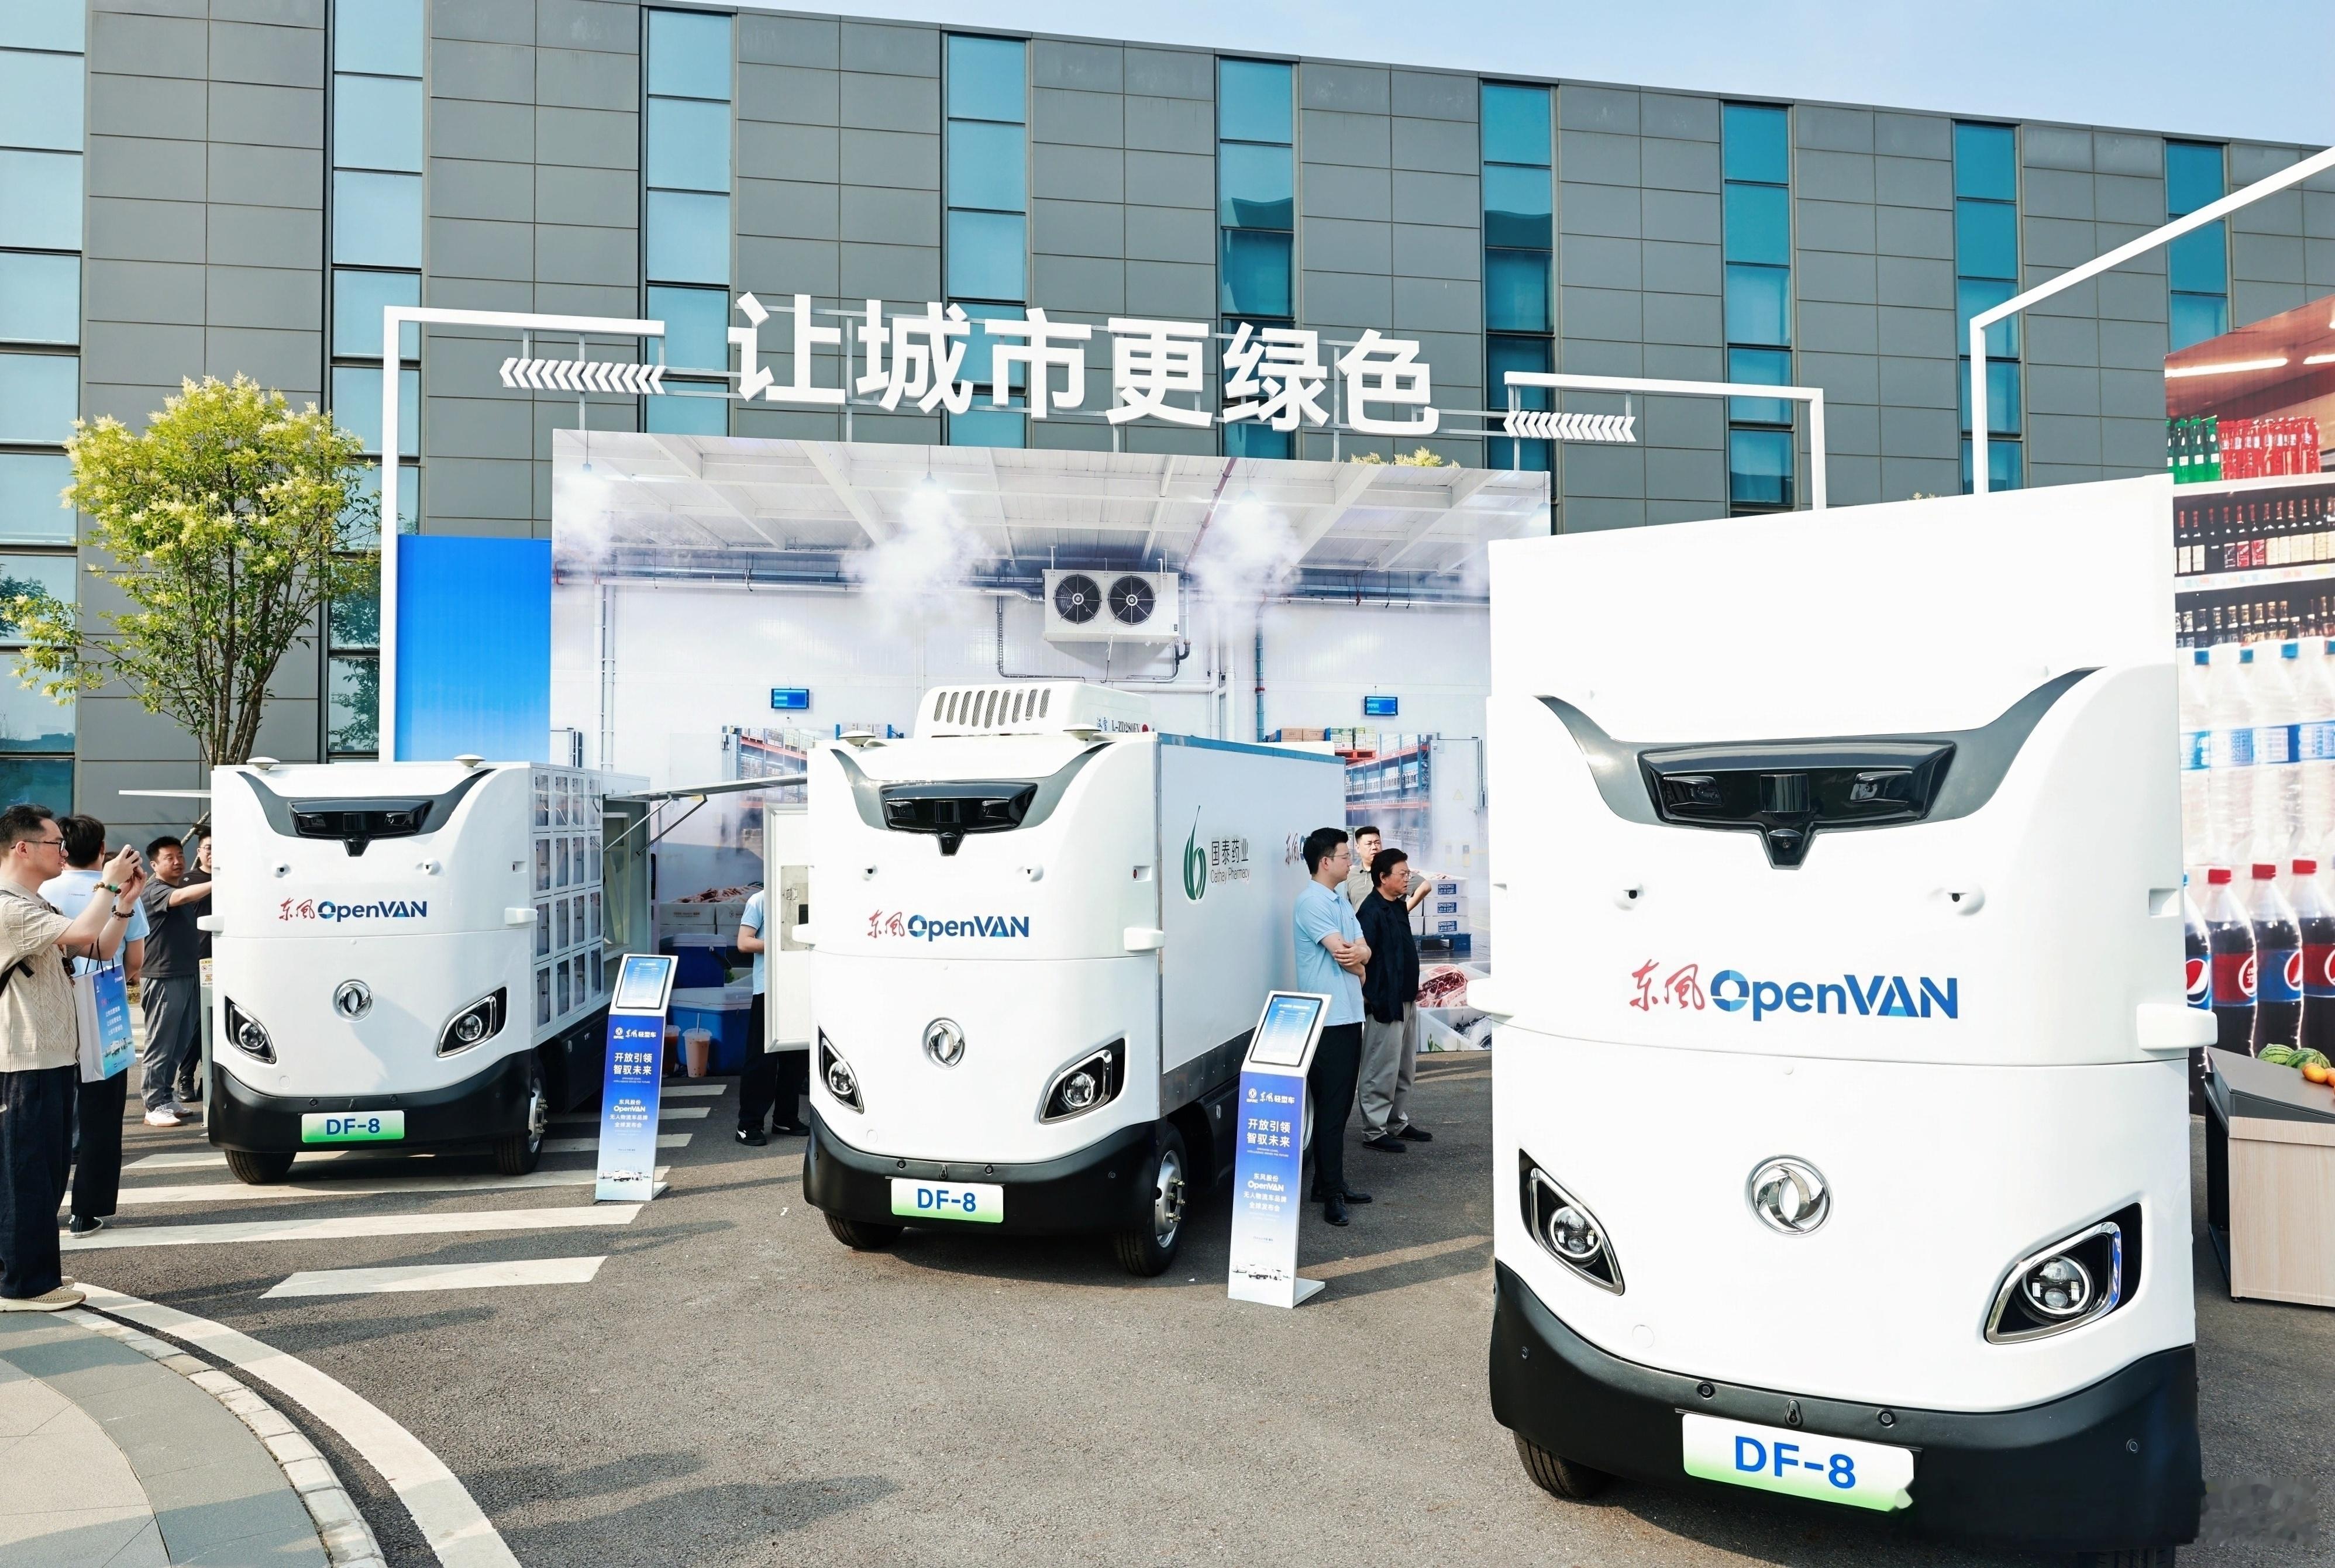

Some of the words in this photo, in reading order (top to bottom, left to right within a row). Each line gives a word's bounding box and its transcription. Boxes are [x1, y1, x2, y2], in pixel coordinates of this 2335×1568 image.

[728, 291, 1439, 436] 让城市更绿色
[1211, 838, 1249, 866] 国泰药业
[1211, 869, 1228, 884] Cathay
[1228, 866, 1250, 881] Pharmacy
[318, 901, 427, 922] OpenVAN
[908, 915, 1029, 942] OpenVAN
[1710, 969, 1958, 1022] OpenVAN
[614, 1052, 653, 1063] 开放引领
[613, 1064, 652, 1076] 智驭未来
[326, 1118, 380, 1135] DF-8
[1248, 1118, 1291, 1133] 开放引领
[1246, 1132, 1290, 1147] 智驭未来
[1247, 1180, 1284, 1192] OpenVAN
[918, 1188, 976, 1212] DF-8
[1735, 1435, 1856, 1489] DF-8
